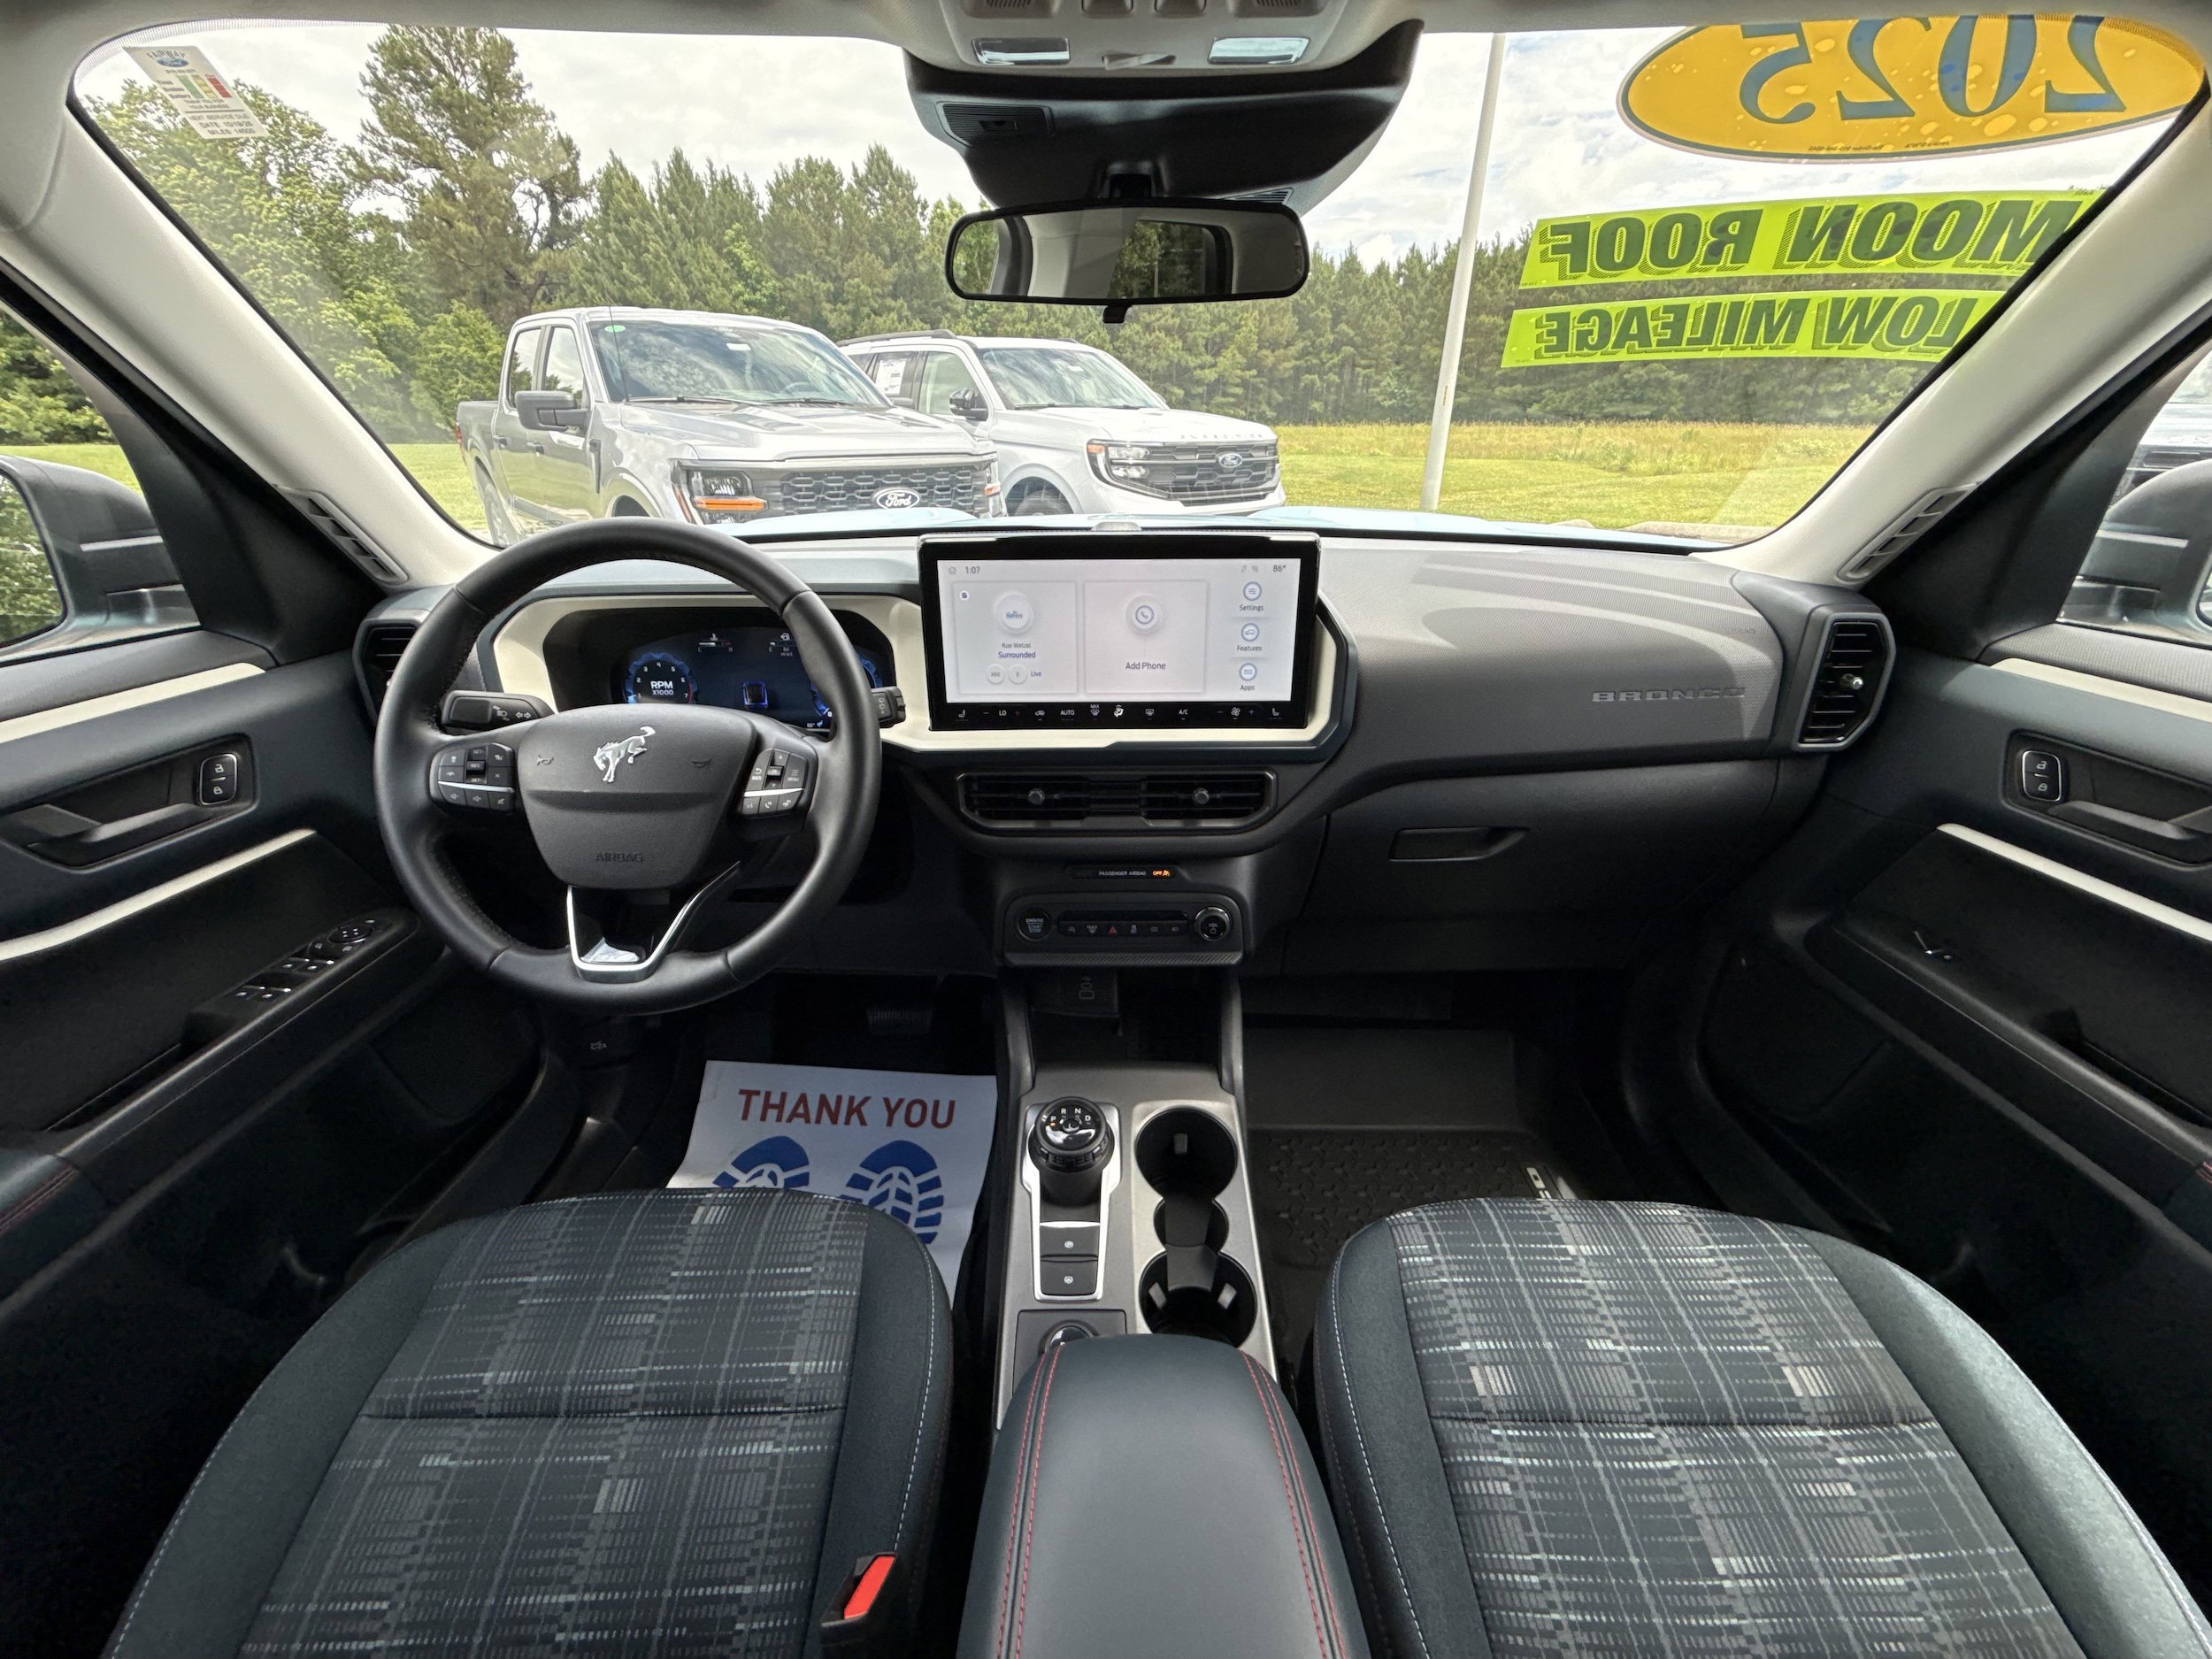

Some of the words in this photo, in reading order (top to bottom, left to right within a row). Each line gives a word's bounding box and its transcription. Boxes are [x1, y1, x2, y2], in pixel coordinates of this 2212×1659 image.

[146, 50, 187, 60] FAIRWAY
[885, 493, 912, 507] Ford
[1125, 662, 1141, 671] Add
[1141, 662, 1167, 671] Phone
[650, 680, 673, 689] RPM
[1592, 687, 1745, 702] BRONCO
[595, 851, 644, 863] AIRBAG
[738, 1088, 872, 1126] THANK
[882, 1096, 956, 1129] YOU
